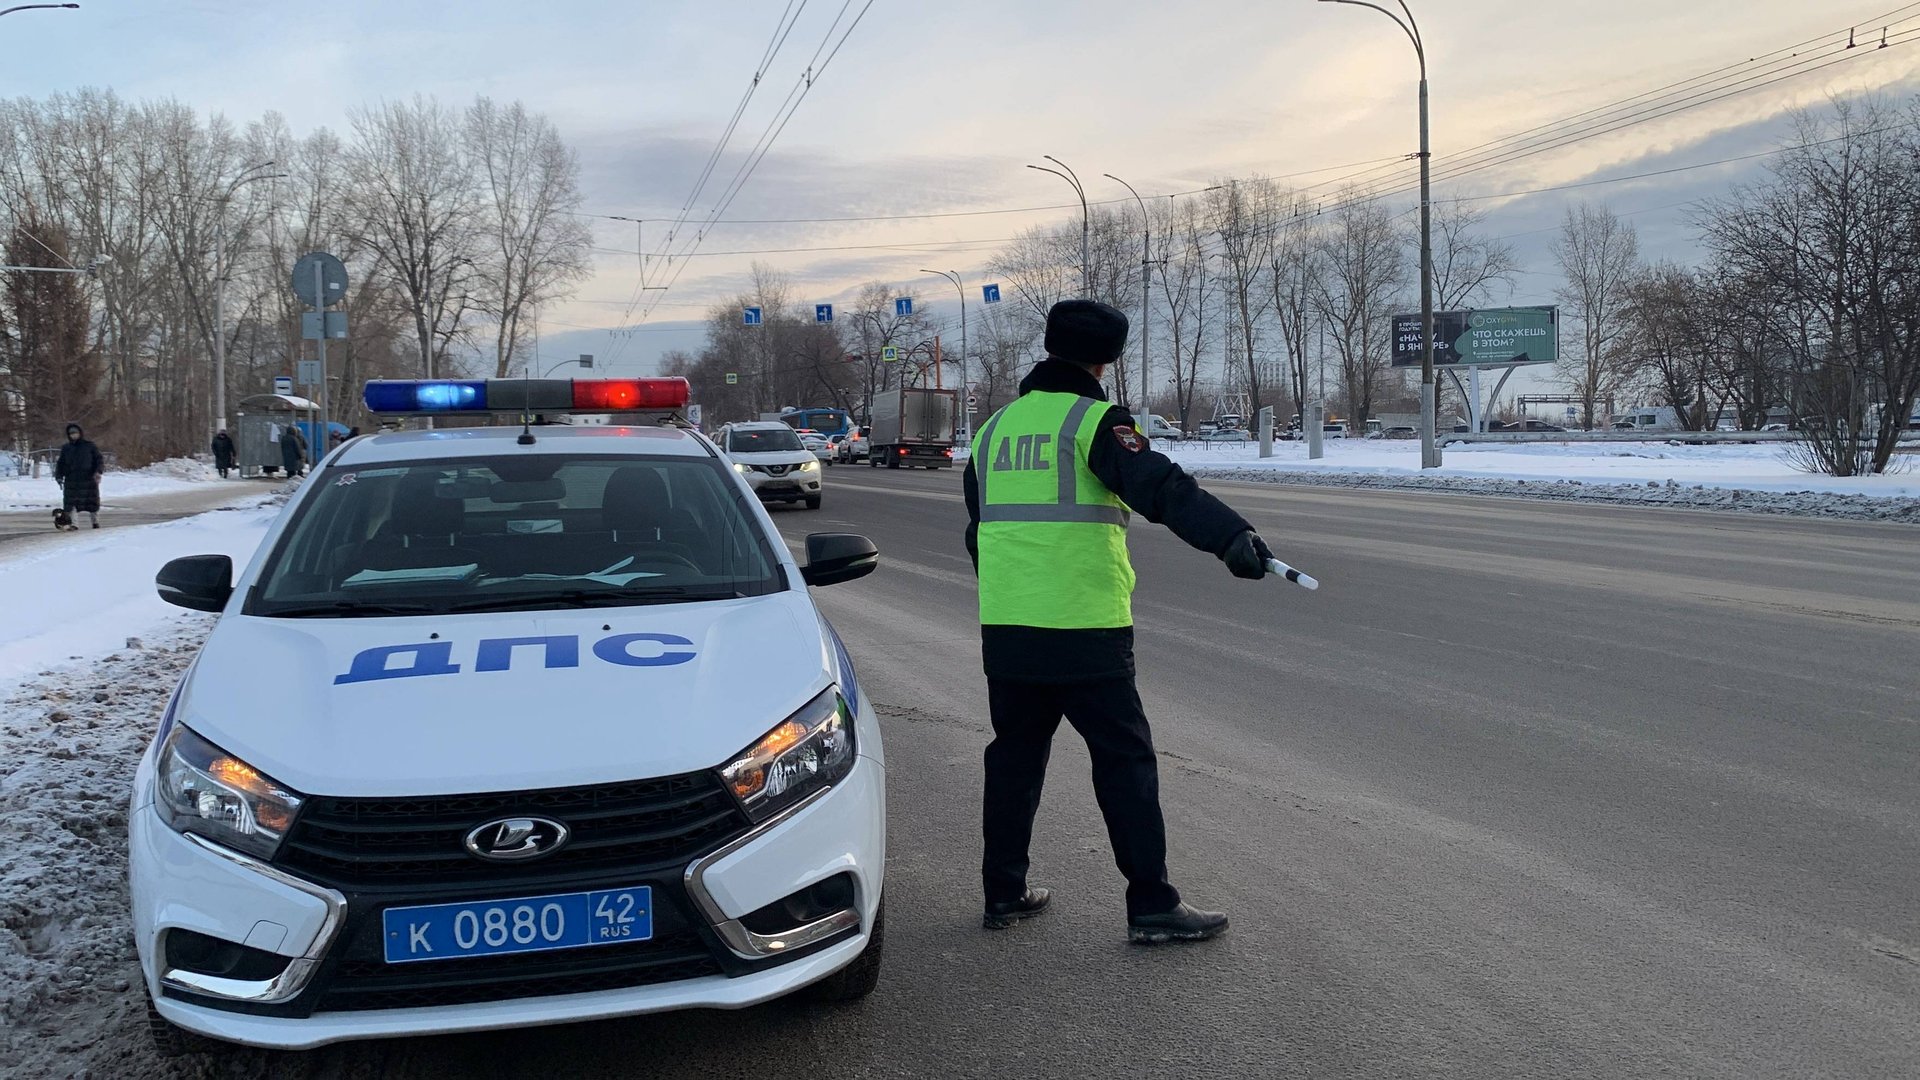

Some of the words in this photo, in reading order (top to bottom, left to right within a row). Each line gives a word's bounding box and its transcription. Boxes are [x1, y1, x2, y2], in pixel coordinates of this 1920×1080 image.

[1472, 329, 1492, 338] ЧТО
[1494, 327, 1546, 338] СКАЖЕШЬ
[1399, 343, 1406, 351] В
[1472, 340, 1479, 348] В
[1481, 338, 1515, 348] ЭТОМ?
[993, 433, 1051, 472] ДПС
[333, 632, 697, 686] ДПС
[454, 902, 565, 950] 0880
[594, 893, 636, 925] 42
[600, 924, 632, 939] RUS
